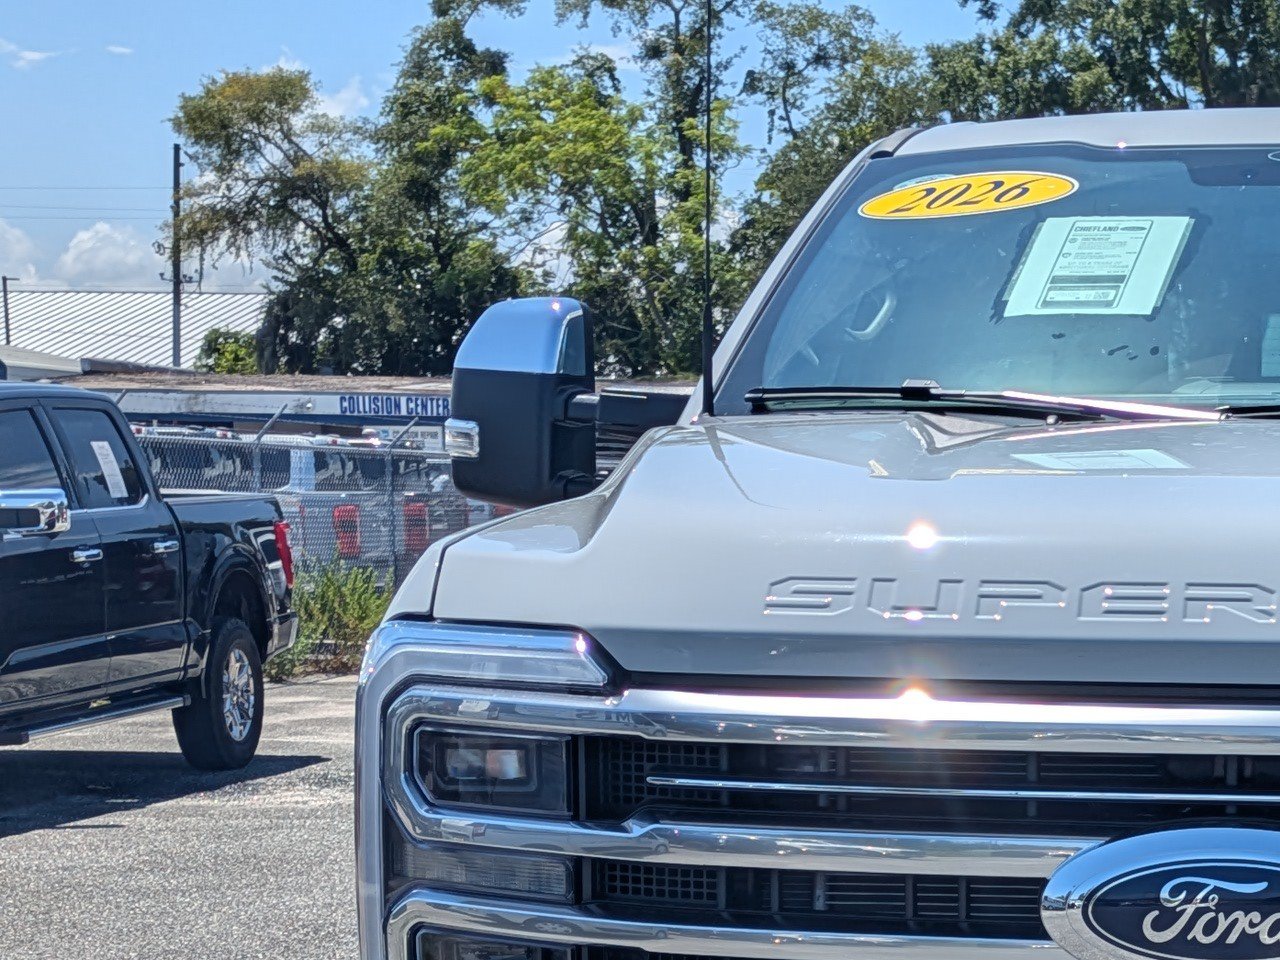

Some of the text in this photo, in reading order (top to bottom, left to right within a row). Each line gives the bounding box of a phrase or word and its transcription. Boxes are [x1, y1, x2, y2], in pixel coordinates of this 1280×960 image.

[885, 178, 1048, 215] 2026
[339, 396, 450, 417] COLLISION CENTER
[764, 576, 1277, 624] SUPER
